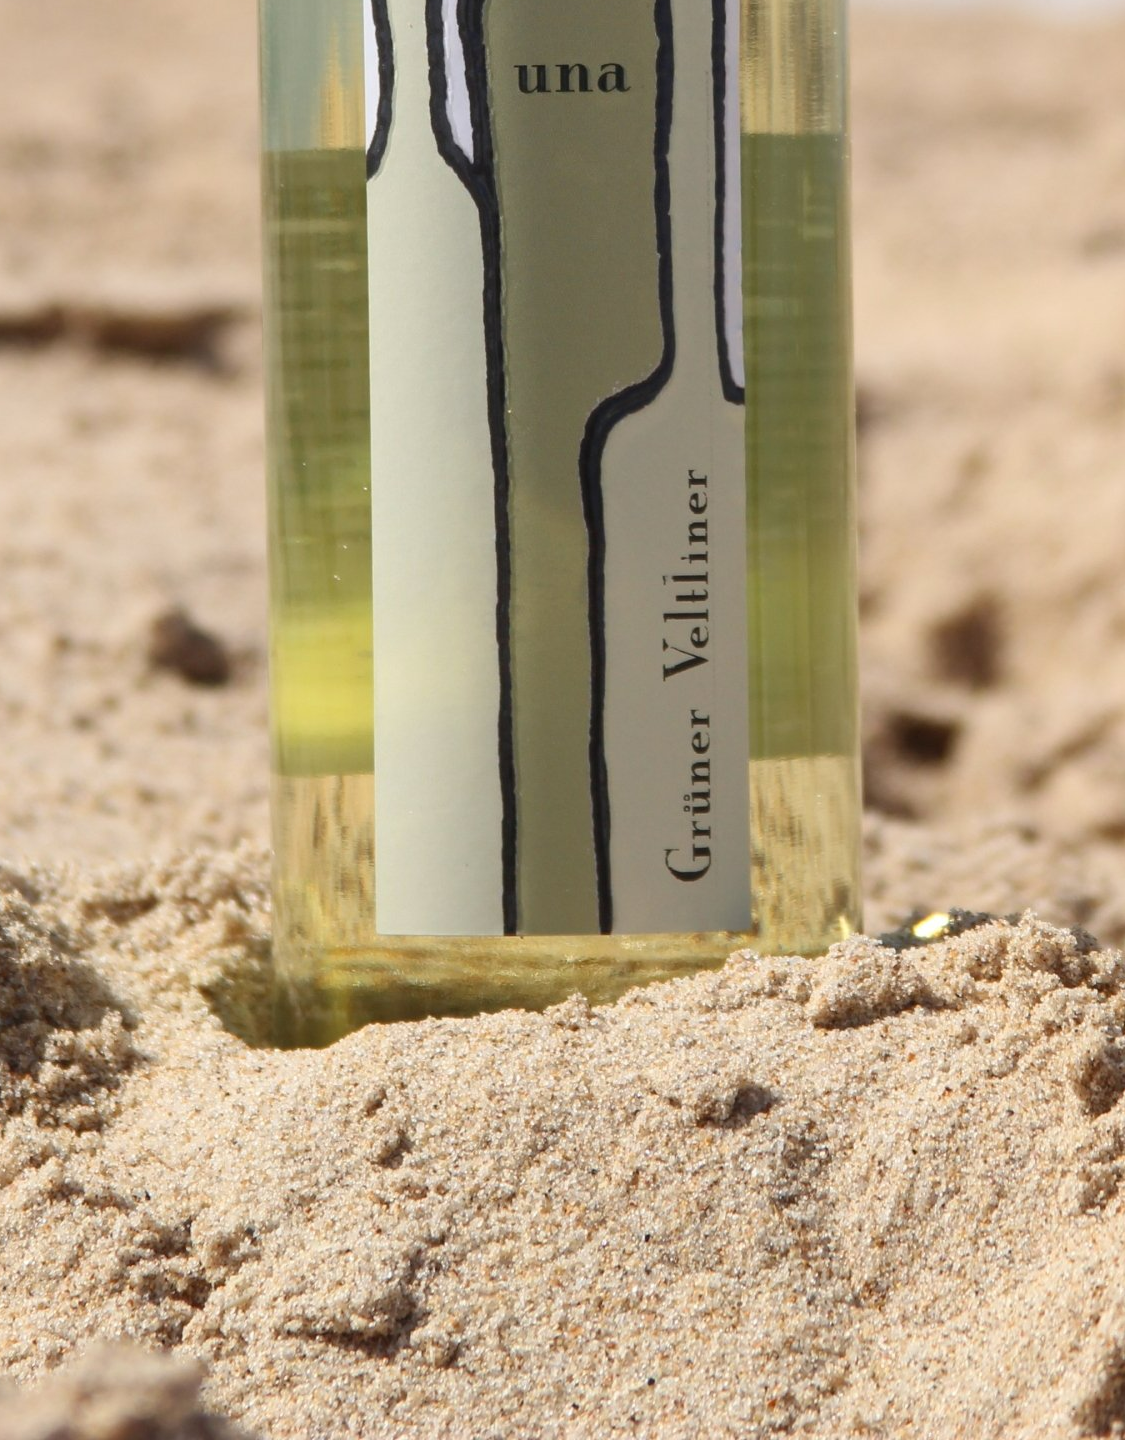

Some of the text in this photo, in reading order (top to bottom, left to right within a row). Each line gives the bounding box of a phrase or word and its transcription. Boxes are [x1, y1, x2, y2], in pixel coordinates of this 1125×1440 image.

[513, 62, 632, 94] una
[662, 469, 712, 882] Grüner Veltliner
